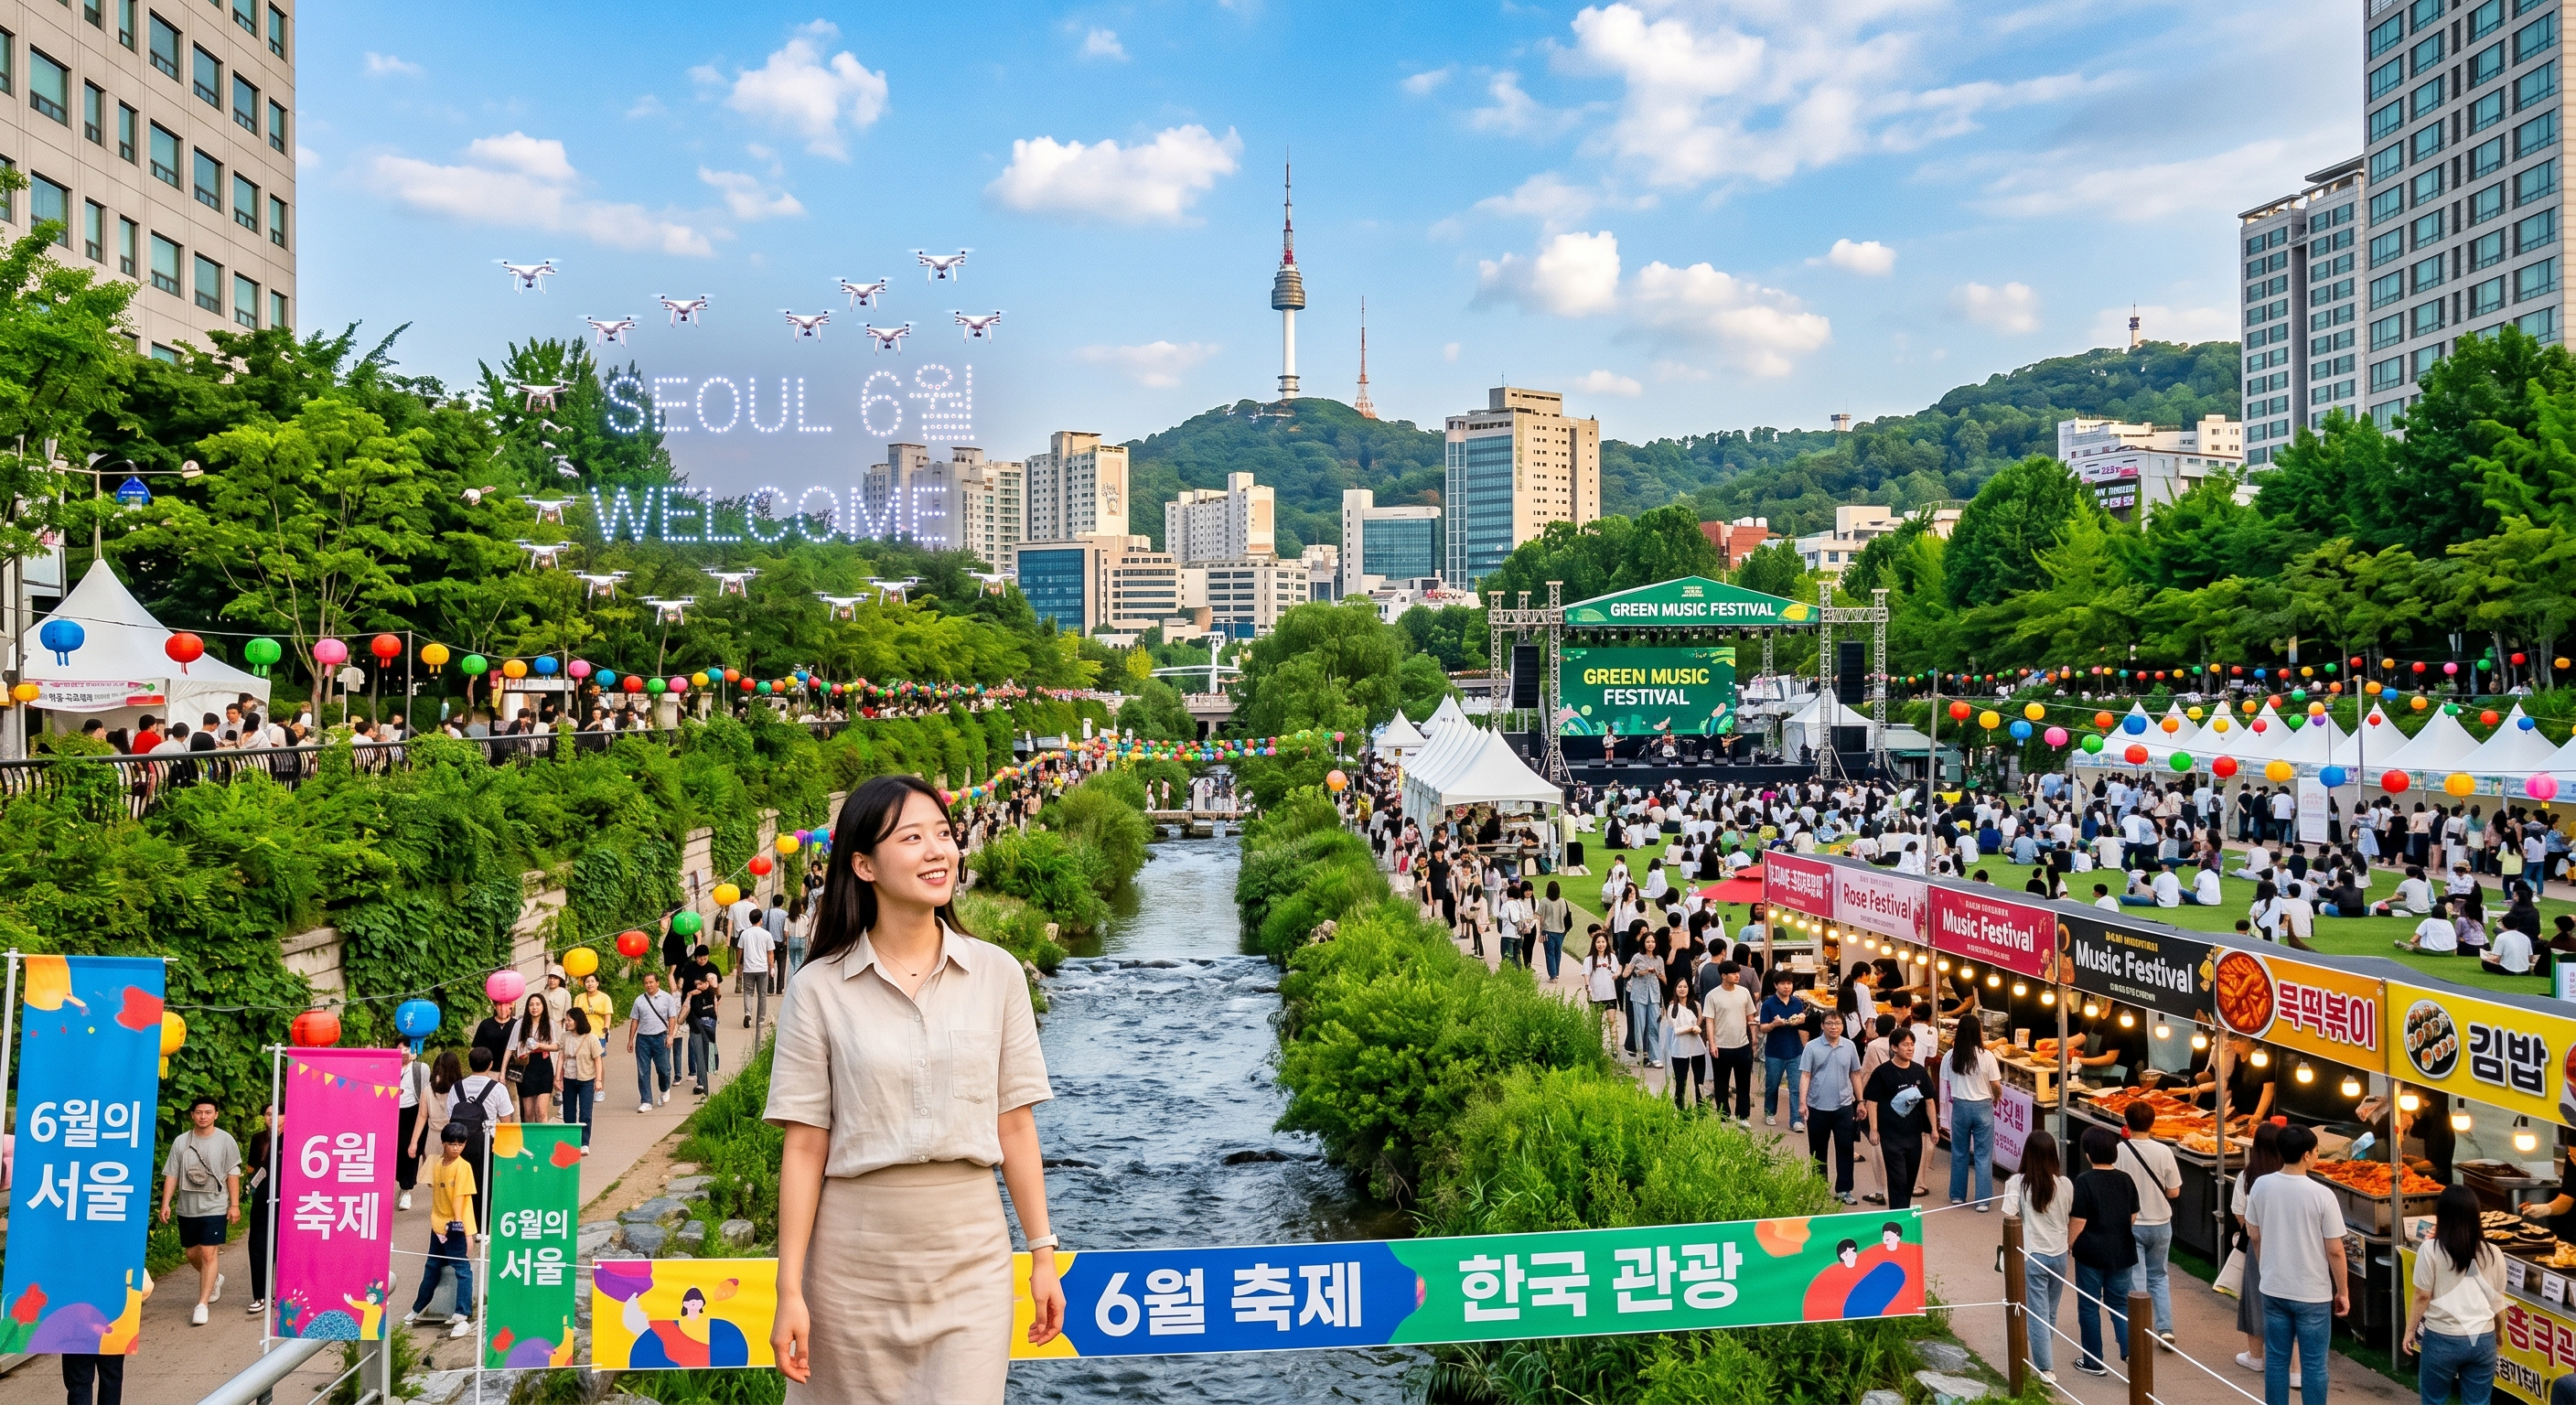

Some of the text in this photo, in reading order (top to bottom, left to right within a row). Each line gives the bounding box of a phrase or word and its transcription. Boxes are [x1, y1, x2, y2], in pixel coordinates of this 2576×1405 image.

[606, 363, 975, 441] SEOUL 6월
[590, 485, 948, 543] WELCOME
[1610, 602, 1776, 617] GREEN MUSIC FESTIVAL
[1583, 668, 1710, 685] GREEN MUSIC
[1604, 688, 1690, 705] FESTIVAL
[1843, 883, 1912, 920] Rose Festival
[1942, 906, 1978, 939] Music
[1980, 915, 2034, 953] Festival
[2076, 938, 2121, 977] Music
[2125, 950, 2194, 994] Festival
[2278, 980, 2376, 1050] 묵떡볶이
[2468, 1023, 2549, 1096] 김밥
[29, 1099, 141, 1149] 6월의
[300, 1132, 376, 1184] 6월
[26, 1160, 134, 1222] 서울
[293, 1190, 380, 1241] 축제
[499, 1208, 568, 1240] 6월의
[499, 1247, 568, 1286] 서울
[1095, 1241, 1743, 1337] 6월 축제 한국 관광
